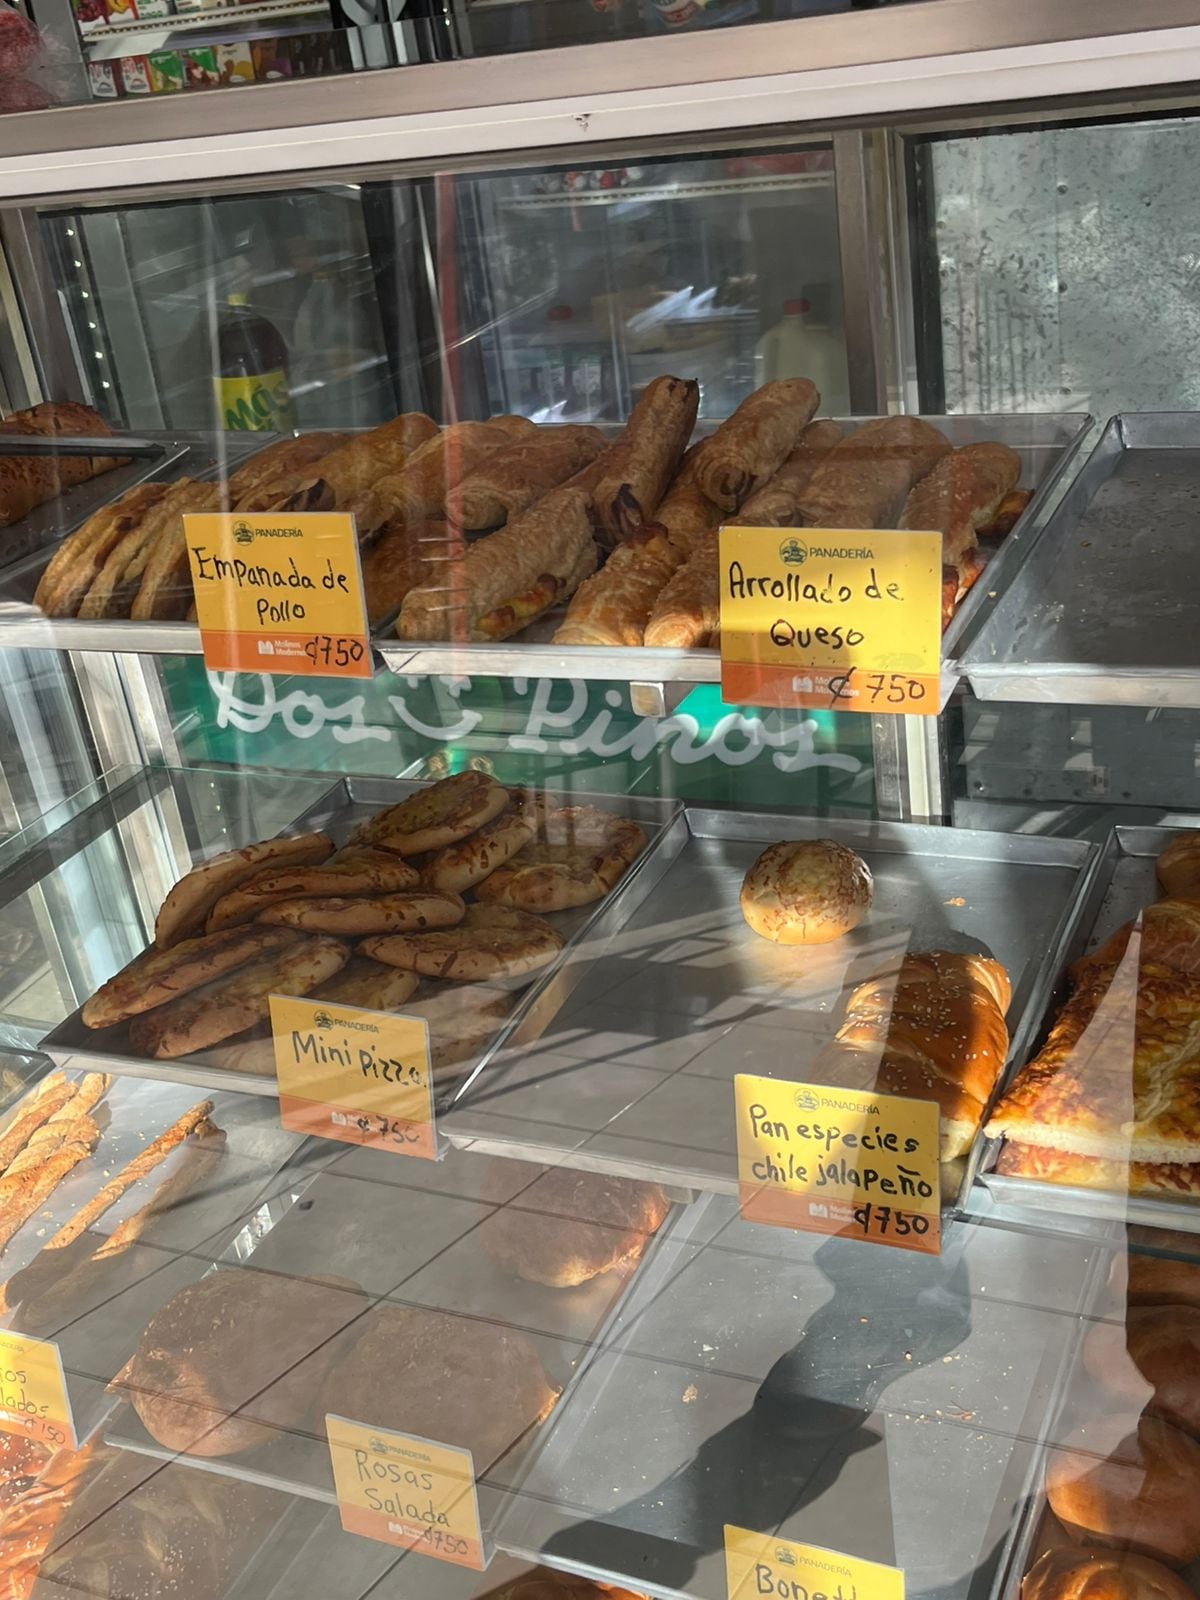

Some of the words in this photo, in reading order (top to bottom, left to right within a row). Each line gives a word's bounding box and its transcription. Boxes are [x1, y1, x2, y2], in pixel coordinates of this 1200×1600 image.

[254, 527, 304, 539] PANADERÍA
[809, 547, 874, 560] PANADERÍA
[322, 559, 350, 593] de
[729, 561, 852, 603] Arrollado
[865, 568, 904, 601] de
[256, 598, 306, 625] Pollo
[770, 619, 865, 650] Queso
[508, 677, 862, 772] Pinos
[333, 1018, 380, 1033] PANADERÍA
[292, 1030, 351, 1066] Mini
[821, 1098, 880, 1115] PANADERÍA
[749, 1104, 789, 1141] Pan
[796, 1124, 920, 1153] especies
[751, 1152, 808, 1183] chile
[355, 1449, 433, 1491] Rosas
[364, 1488, 451, 1528] Salada
[799, 1557, 853, 1577] PANADERÍA
